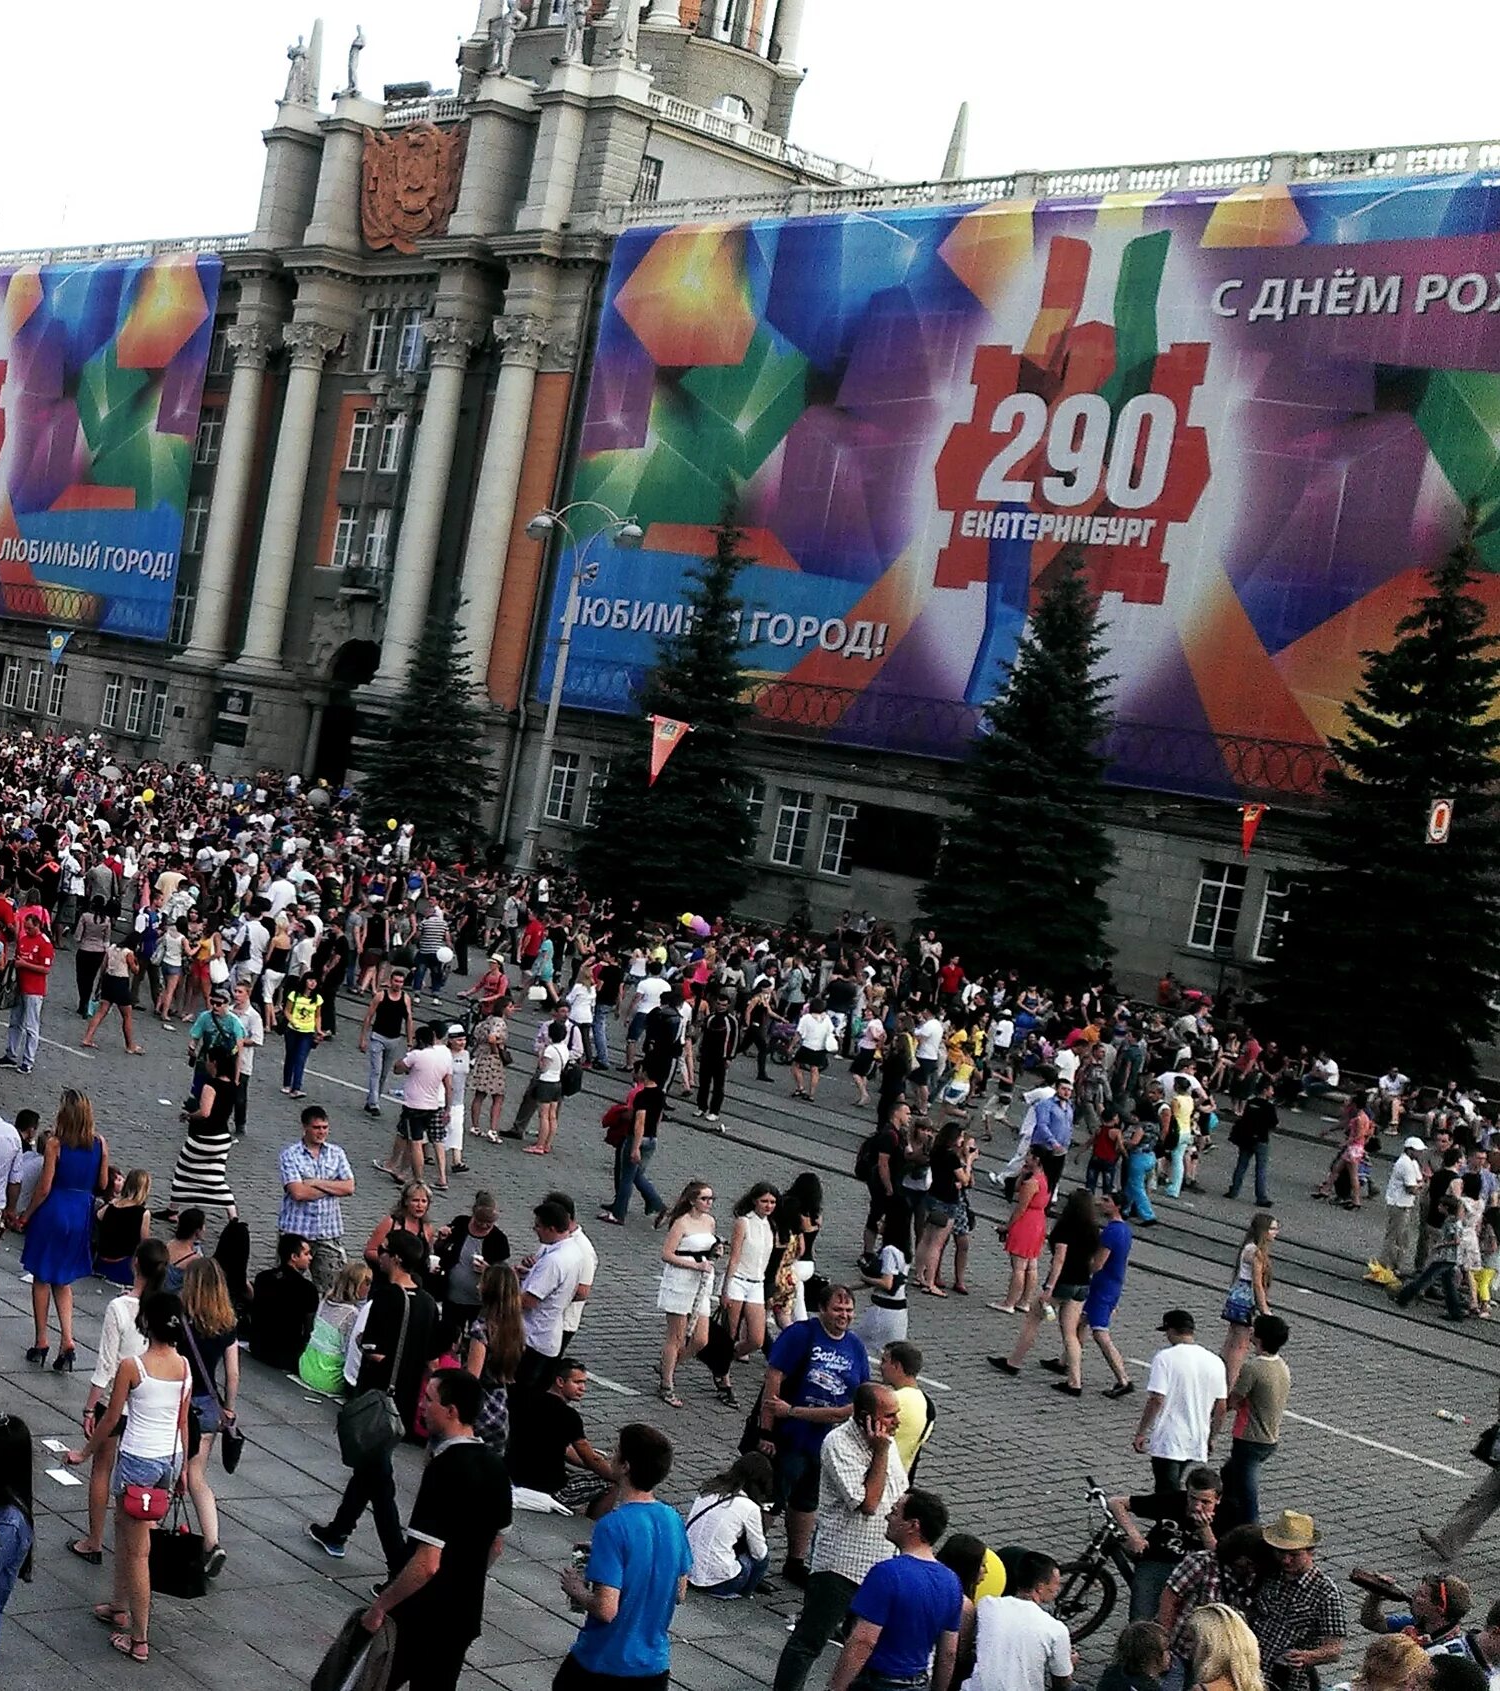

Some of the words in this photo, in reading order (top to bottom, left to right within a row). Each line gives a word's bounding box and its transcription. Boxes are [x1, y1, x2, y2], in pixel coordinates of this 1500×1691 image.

[1210, 279, 1243, 317] С
[1248, 267, 1402, 322] ДНЁМ
[1414, 272, 1500, 314] РО
[975, 392, 1178, 509] 290
[960, 511, 1156, 547] ЕКАТЕРИНБУРГ
[103, 546, 175, 582] ГОРОД!
[559, 596, 743, 641] ЛЮБИМ
[749, 610, 889, 660] ГОРОД!
